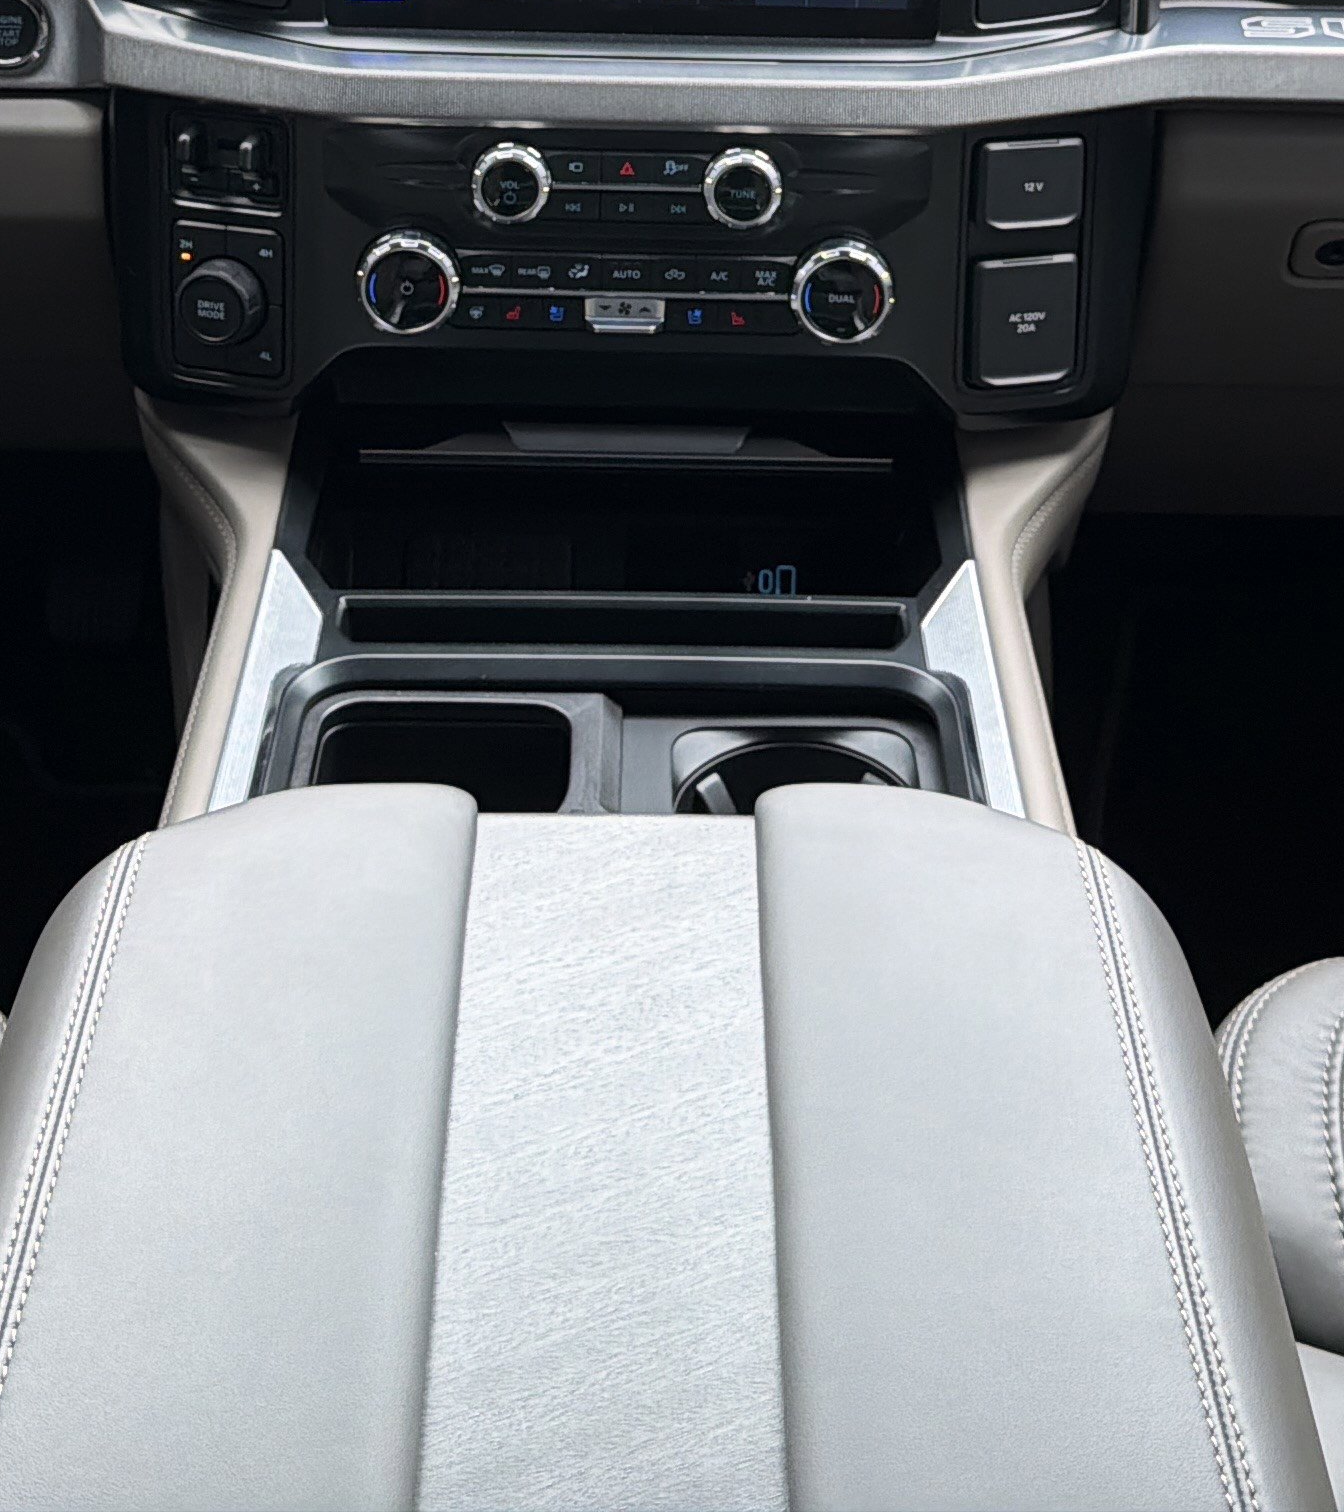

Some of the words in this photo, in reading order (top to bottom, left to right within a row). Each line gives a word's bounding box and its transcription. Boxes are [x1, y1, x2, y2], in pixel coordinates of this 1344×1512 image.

[499, 180, 520, 191] VOL
[730, 190, 756, 200] TUNE
[612, 269, 641, 280] AUTO
[710, 271, 729, 282] A/C
[755, 270, 776, 279] MAX
[758, 277, 775, 287] A/C
[197, 299, 225, 310] DRIVE
[828, 294, 855, 304] DUAL
[197, 309, 225, 320] MODE
